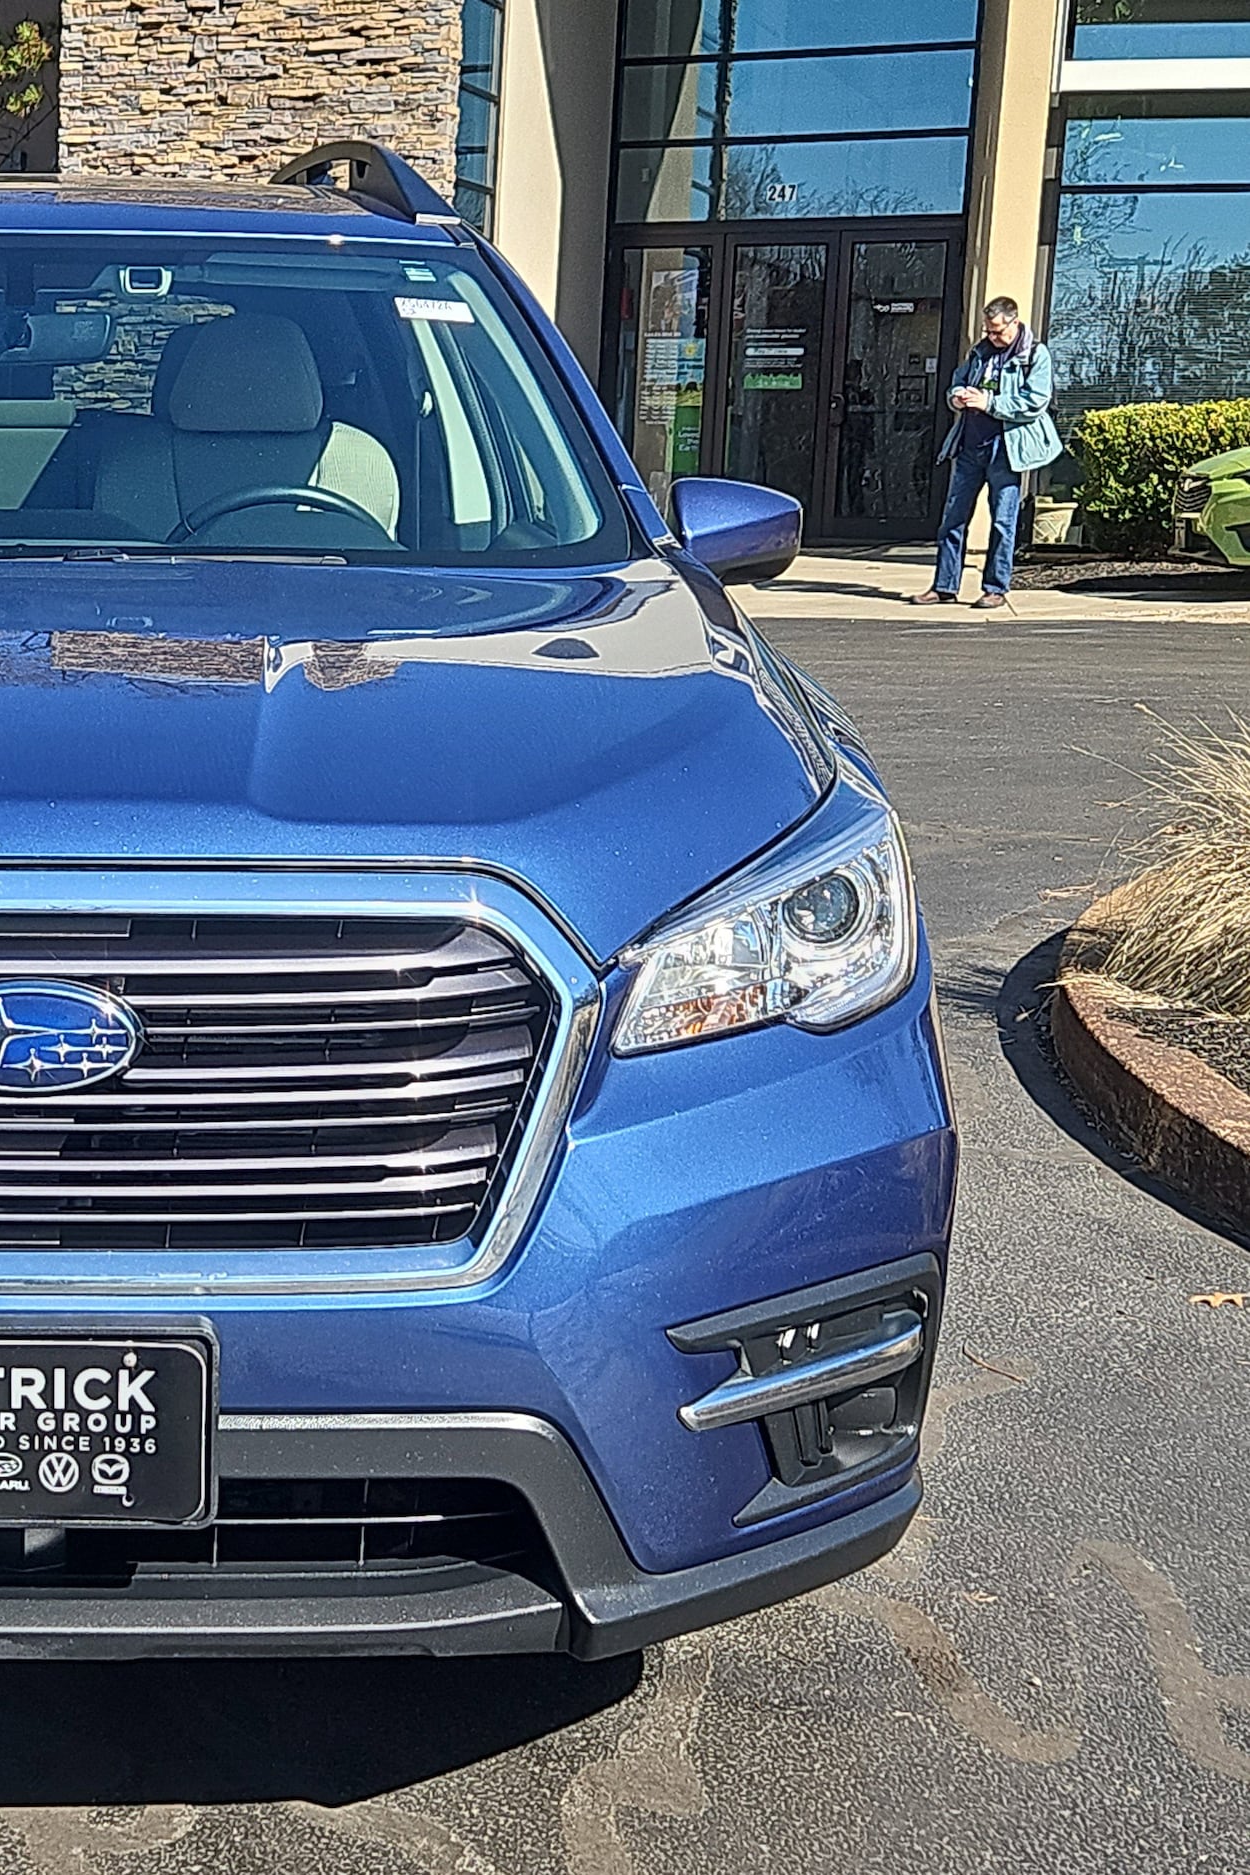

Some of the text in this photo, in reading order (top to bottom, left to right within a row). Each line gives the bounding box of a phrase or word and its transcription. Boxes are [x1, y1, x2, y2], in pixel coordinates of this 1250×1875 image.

[768, 184, 796, 201] 247
[36, 1411, 158, 1435] GROUP
[18, 1434, 91, 1452] SINCE
[102, 1436, 157, 1455] 1936
